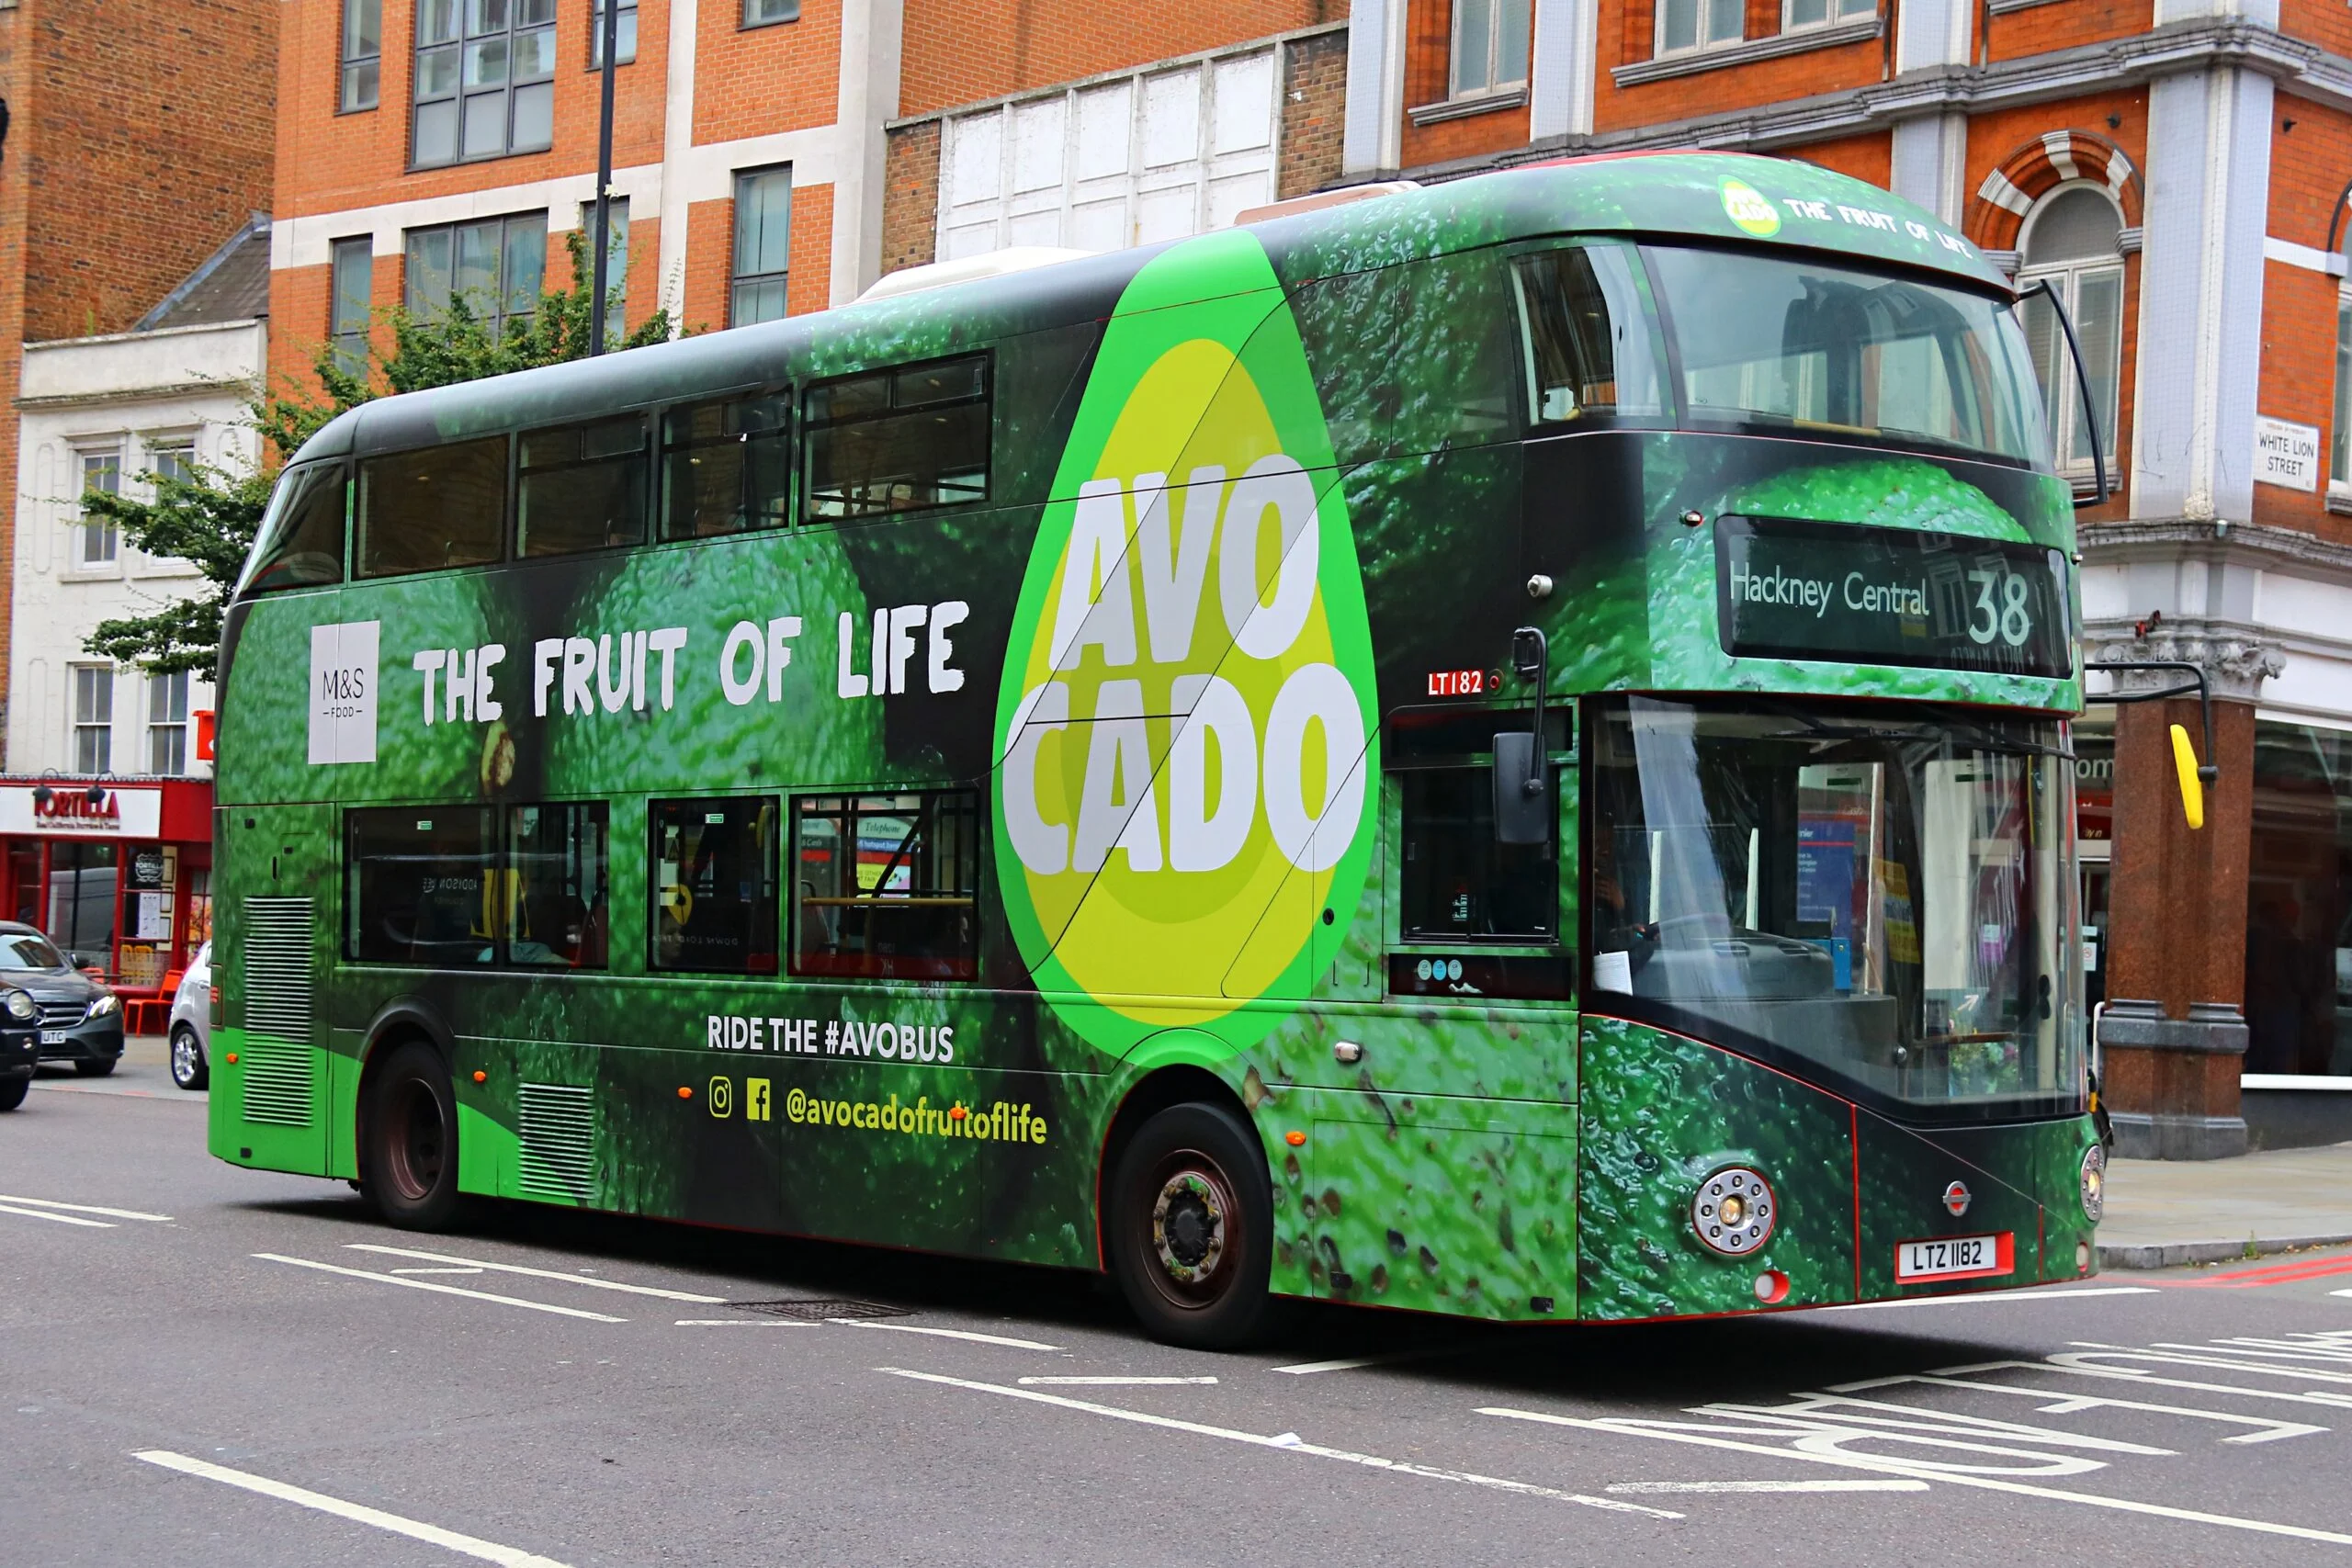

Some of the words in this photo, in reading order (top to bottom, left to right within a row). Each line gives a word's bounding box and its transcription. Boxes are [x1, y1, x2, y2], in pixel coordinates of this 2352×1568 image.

[1782, 198, 1832, 221] THE
[1837, 205, 1897, 233] FRUIT
[1905, 220, 1930, 242] OF
[1935, 231, 1973, 259] LIFE
[2258, 432, 2289, 453] WHITE
[2293, 440, 2314, 458] LION
[2267, 456, 2303, 477] STREET
[1048, 454, 1319, 671] AVO
[1729, 560, 1833, 618] Hackney
[1844, 571, 1929, 616] Central
[1968, 570, 2030, 646] 38
[322, 668, 365, 701] M&S
[413, 644, 506, 727] THE
[534, 627, 687, 717] FRUIT
[719, 616, 803, 705] OF
[838, 601, 969, 698] LIFE
[1428, 671, 1483, 695] LT182
[331, 706, 354, 718] FOOD
[1002, 663, 1366, 874] CADO
[707, 1015, 763, 1051] RIDE
[769, 1018, 818, 1054] THE
[825, 1021, 955, 1063] #AVOBUS
[786, 1088, 1047, 1145] @avocadofruitoflife
[1913, 1244, 1946, 1270] LTZ
[1951, 1241, 1982, 1266] 1182
